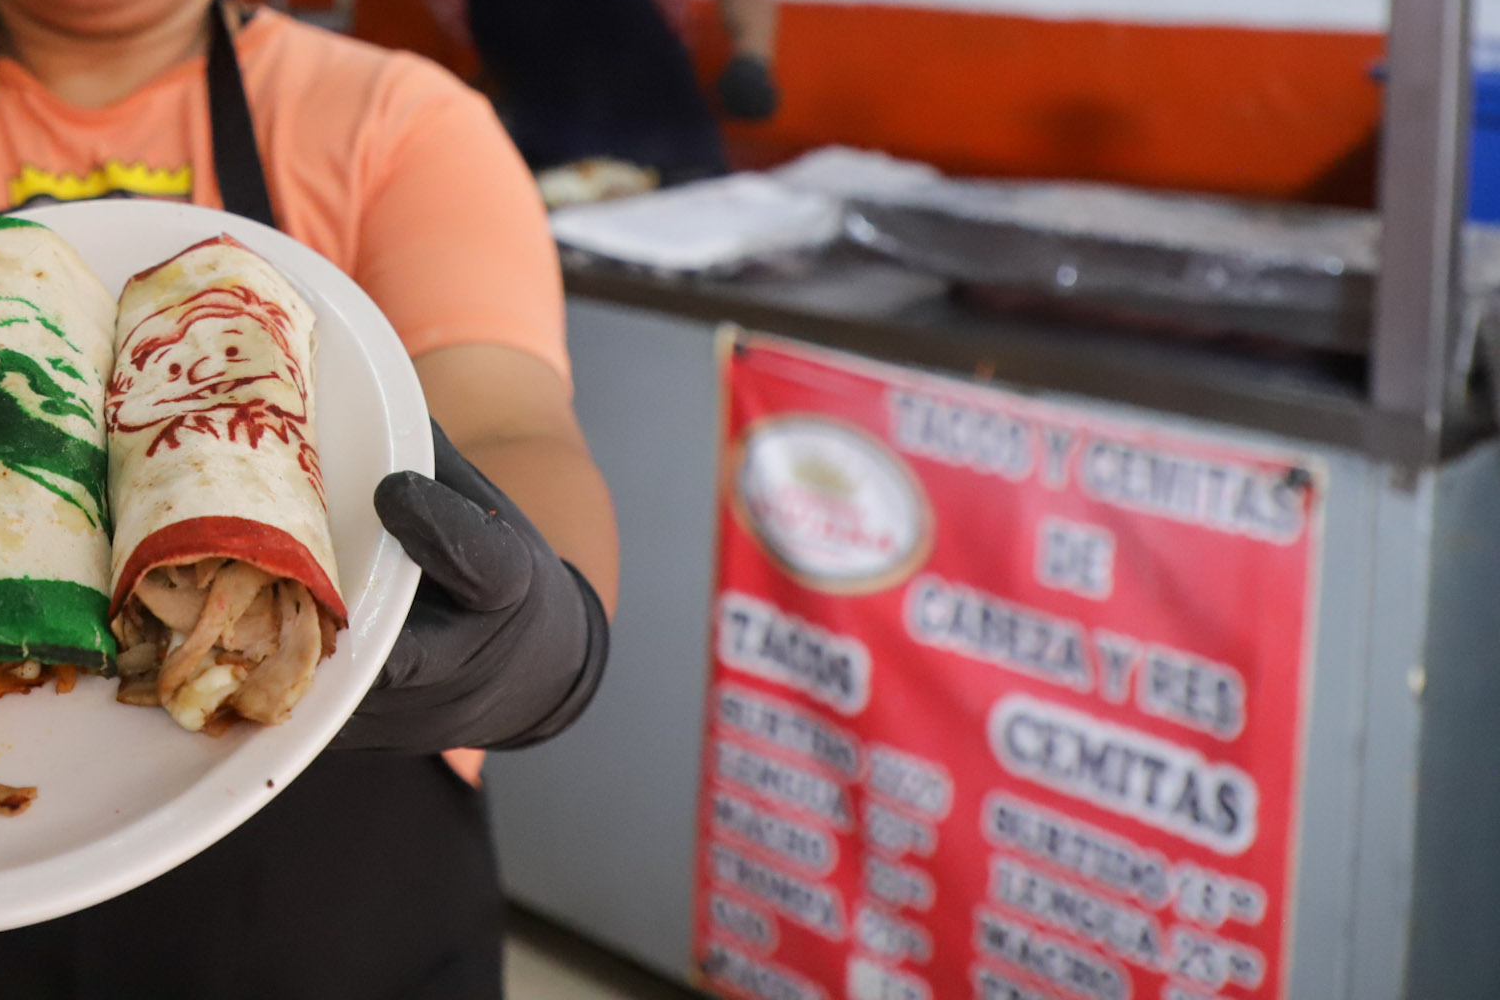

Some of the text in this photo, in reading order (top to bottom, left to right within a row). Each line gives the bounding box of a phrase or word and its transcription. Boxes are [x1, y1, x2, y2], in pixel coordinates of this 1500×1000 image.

[1044, 428, 1073, 487] Y
[1041, 520, 1111, 597] DE
[725, 598, 863, 709] TACOS
[1098, 634, 1137, 700] Y
[1142, 648, 1242, 739] RES
[1000, 706, 1245, 840] CEMITAS
